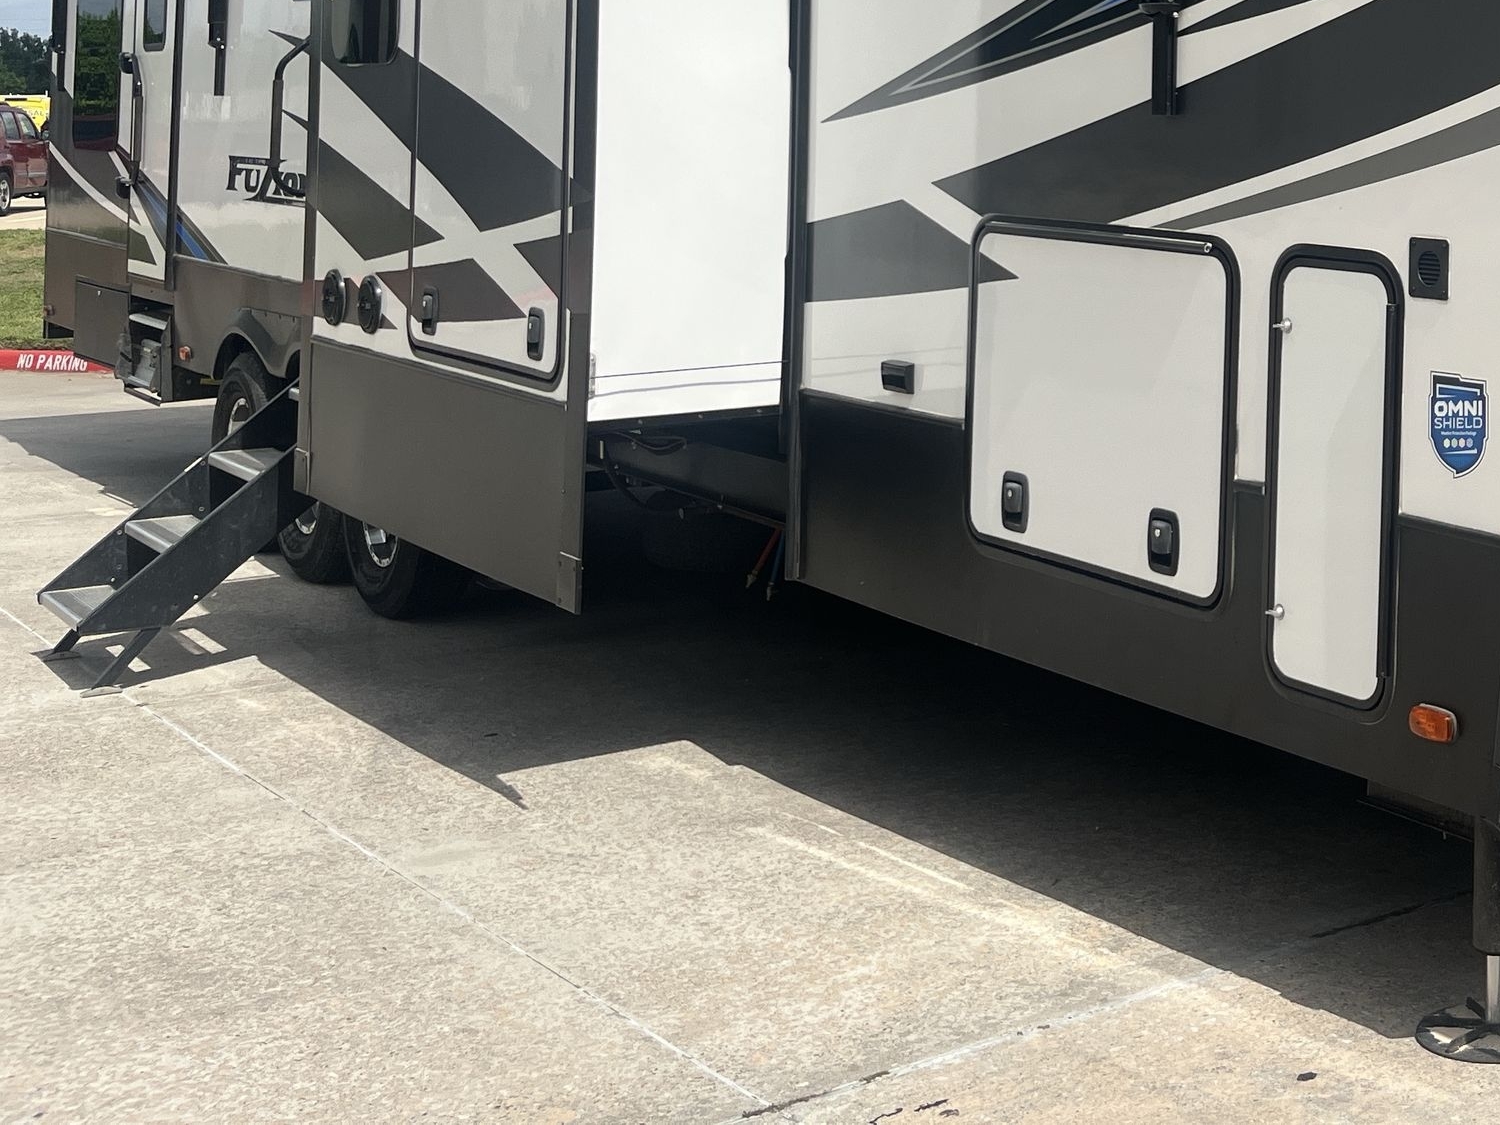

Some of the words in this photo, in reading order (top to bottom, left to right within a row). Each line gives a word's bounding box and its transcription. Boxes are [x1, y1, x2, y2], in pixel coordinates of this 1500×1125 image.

[17, 354, 34, 369] NO
[36, 354, 88, 371] PARKING
[1434, 400, 1483, 416] OMNI
[1434, 417, 1483, 429] SHIELD
